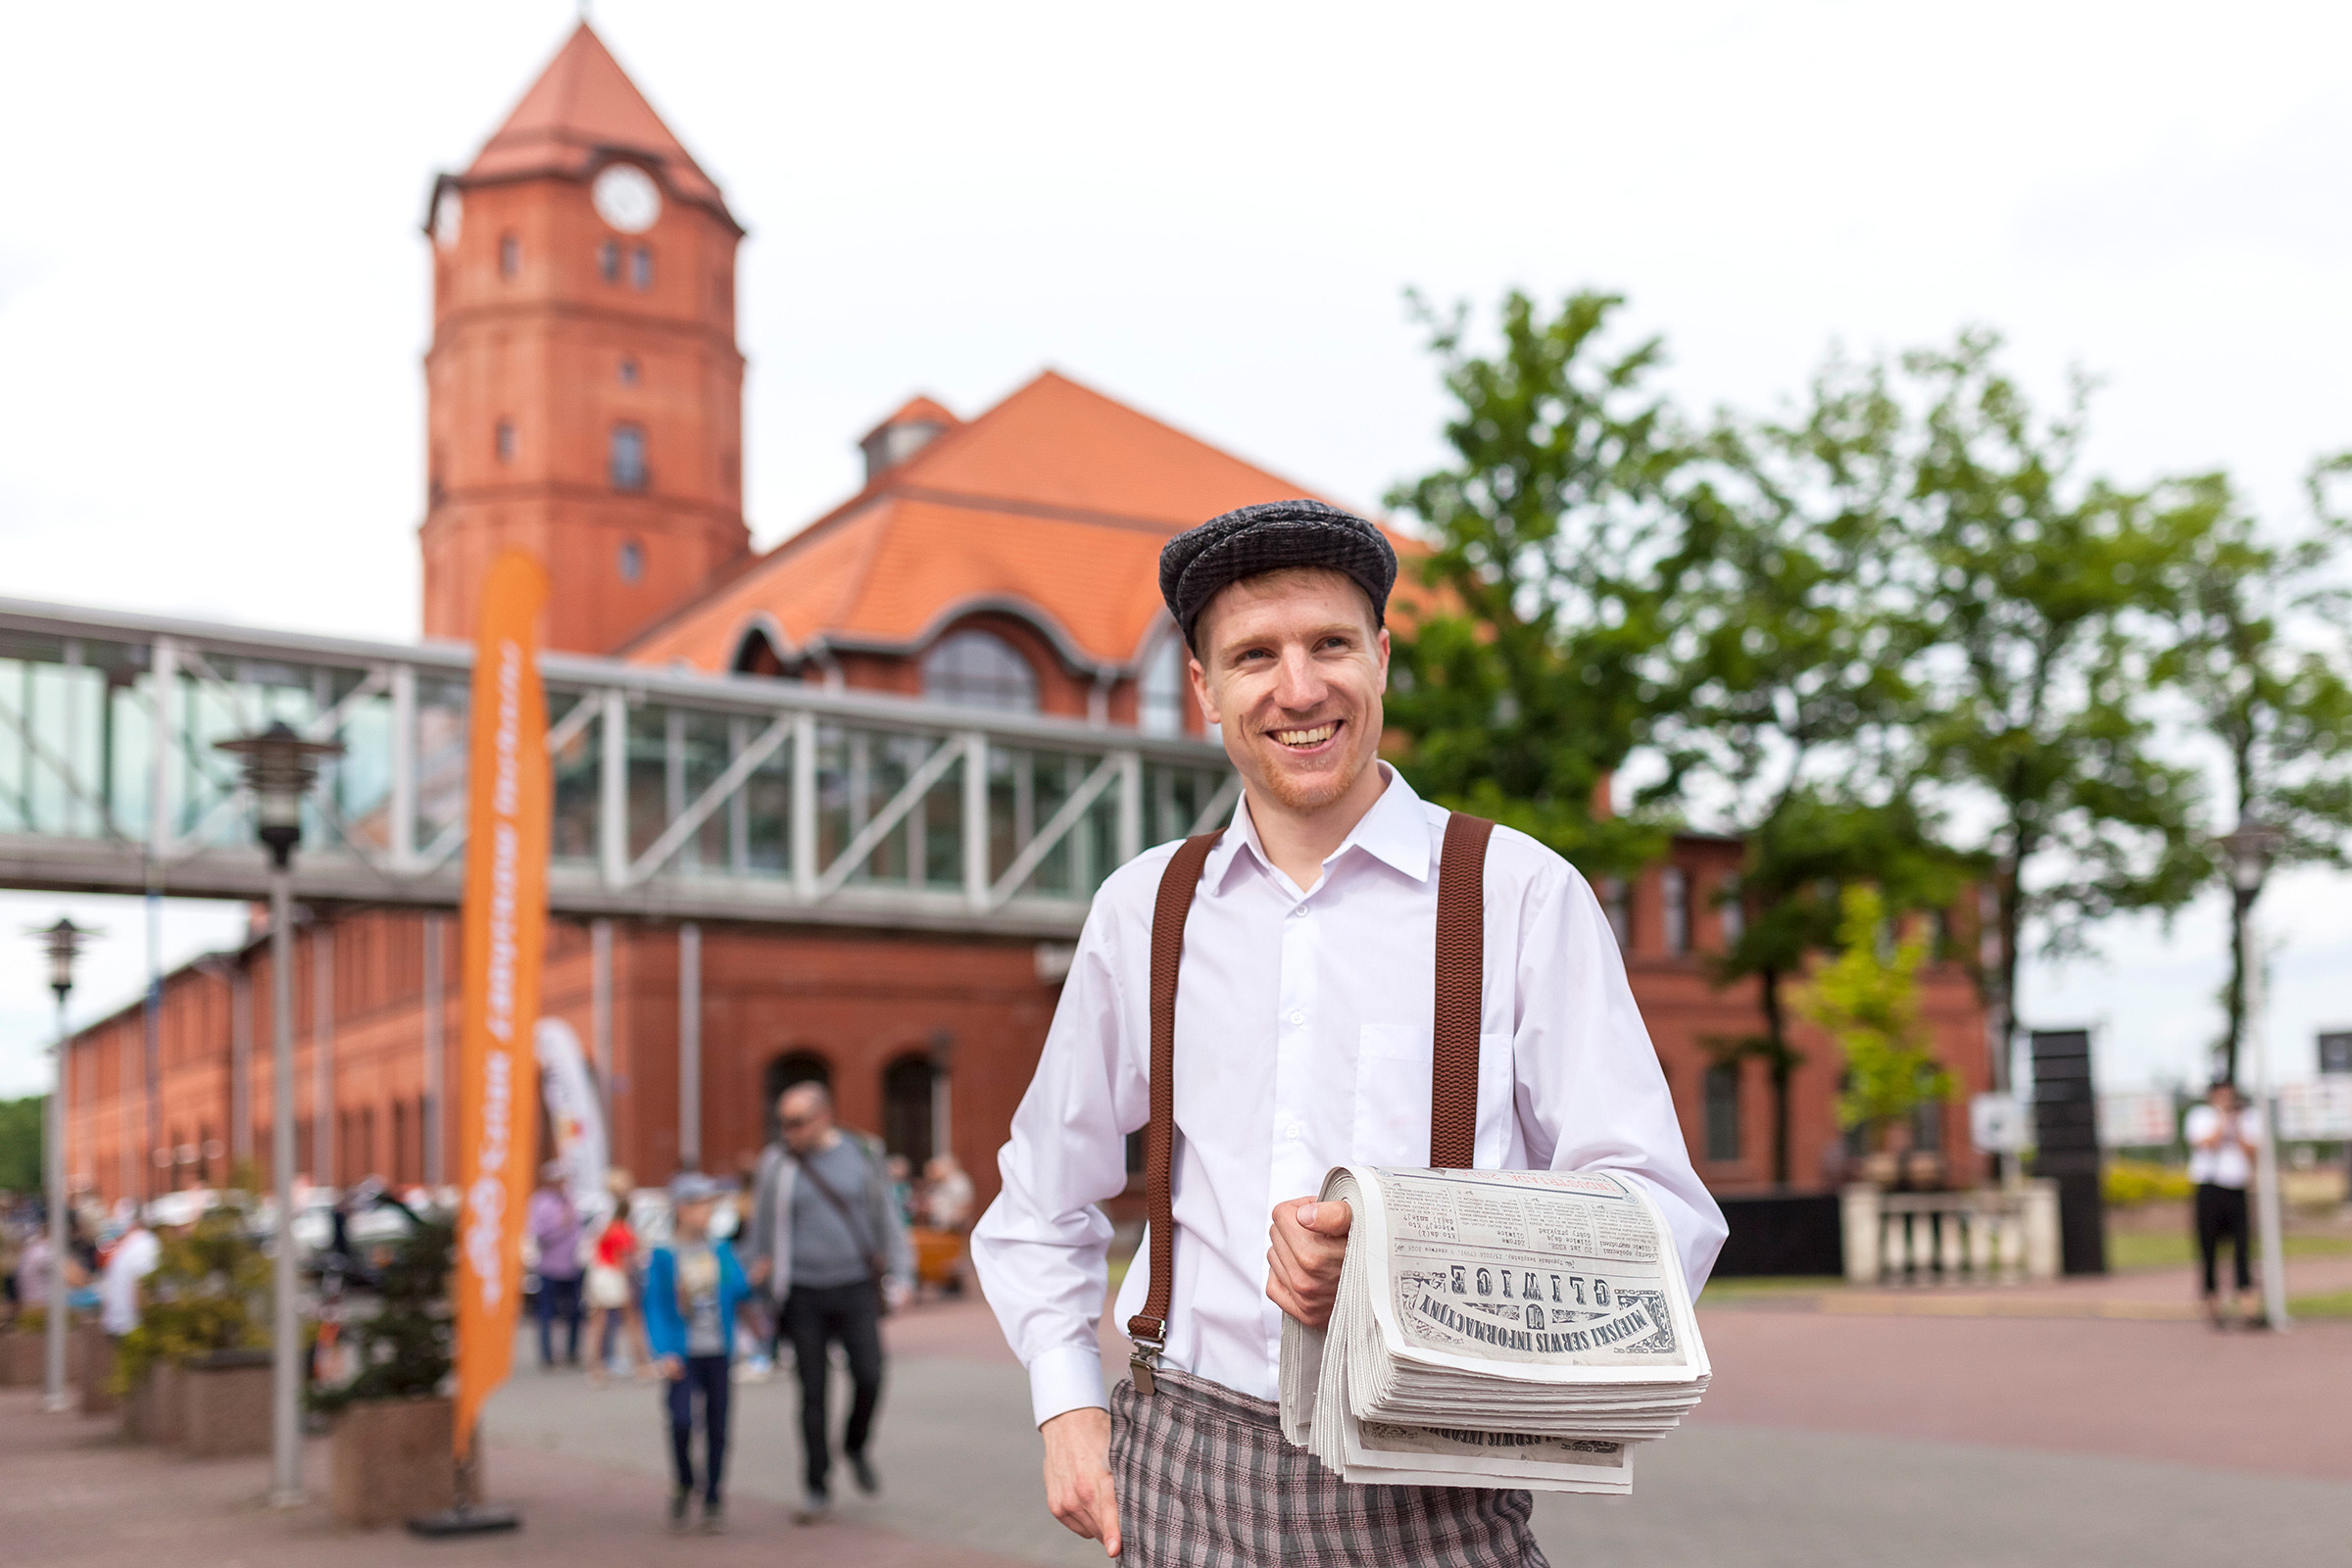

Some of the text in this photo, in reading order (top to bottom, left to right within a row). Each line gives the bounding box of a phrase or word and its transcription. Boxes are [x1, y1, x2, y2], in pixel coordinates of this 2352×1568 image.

[1566, 1237, 1592, 1246] Gliwice
[1451, 1266, 1611, 1307] GLIWICE
[1419, 1294, 1648, 1353] MIEJSKI SERWIS INFORMACYJNY
